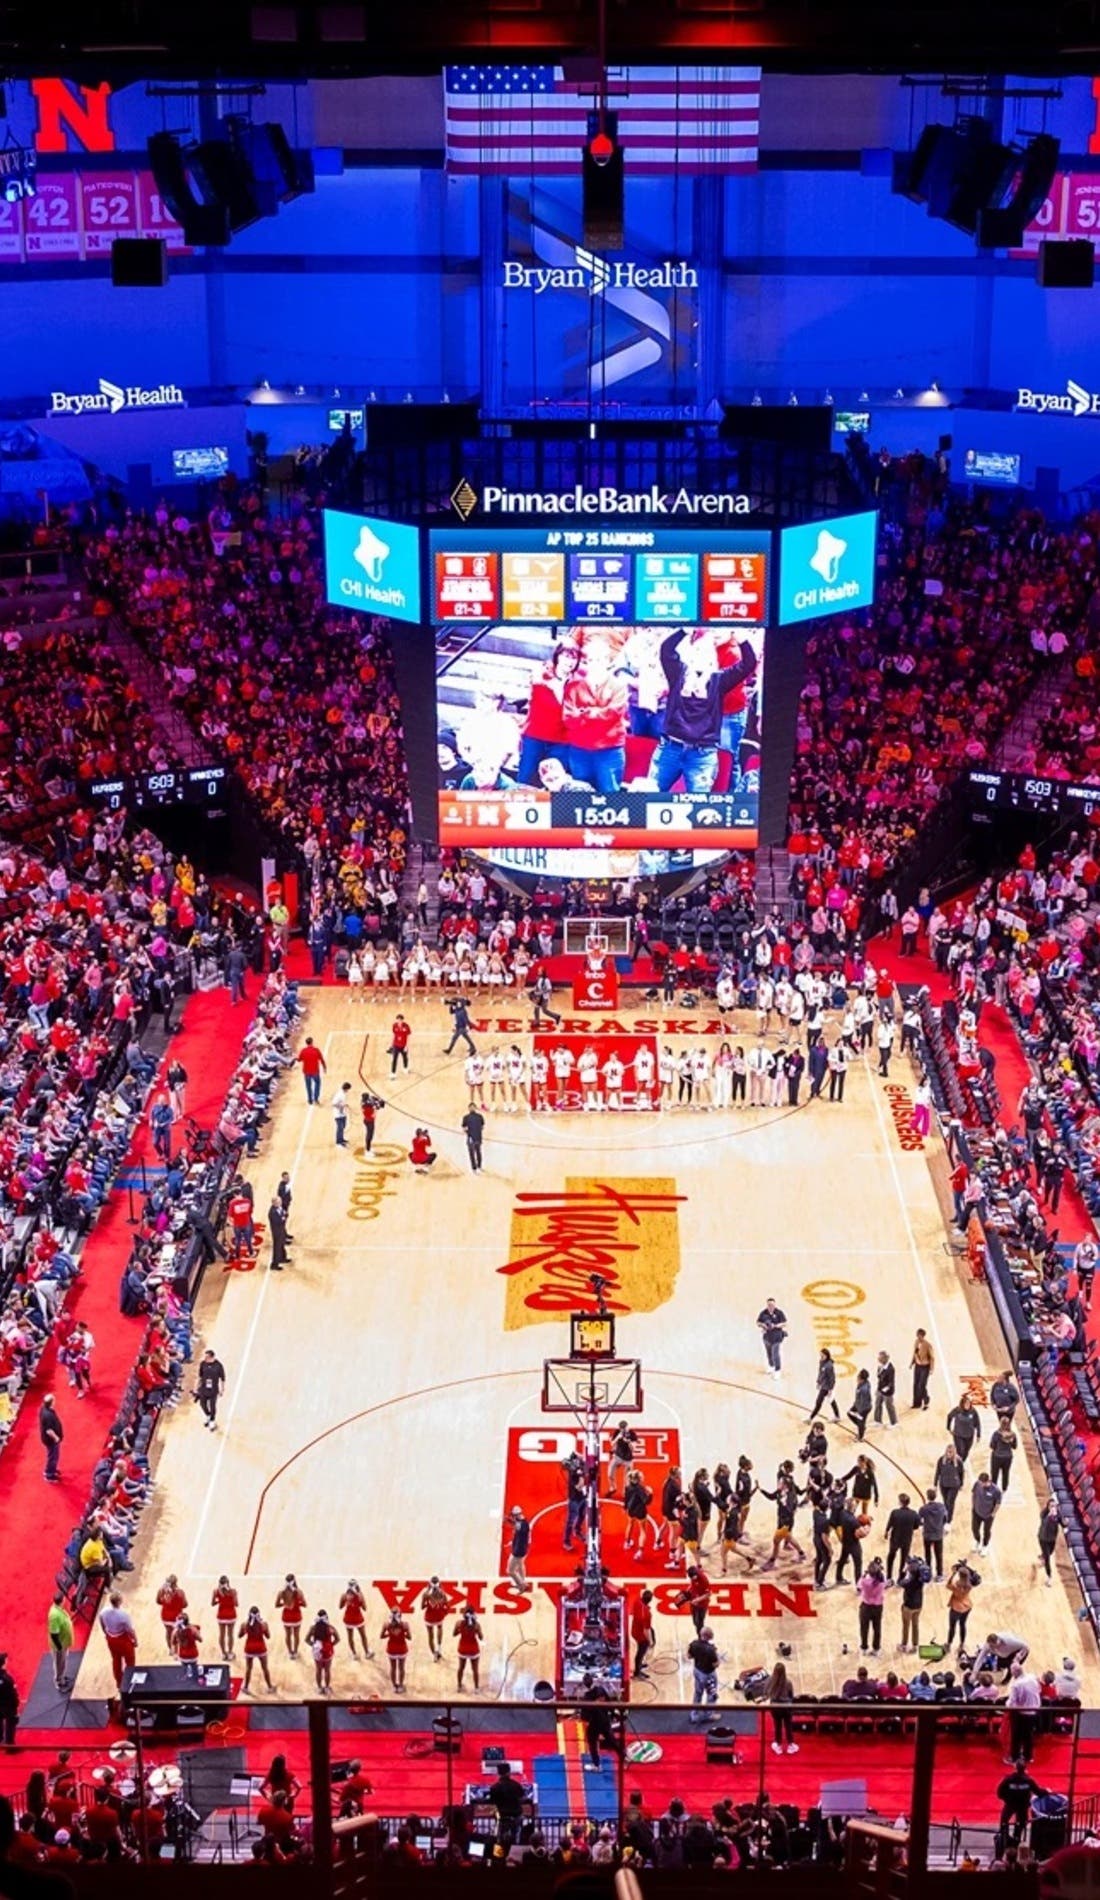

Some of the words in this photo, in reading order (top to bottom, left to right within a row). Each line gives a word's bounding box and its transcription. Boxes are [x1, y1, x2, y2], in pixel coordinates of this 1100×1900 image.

[32, 78, 114, 152] N
[29, 197, 70, 227] 42
[90, 196, 130, 225] 52
[503, 262, 585, 294] Bryan
[614, 262, 699, 287] Health
[51, 392, 109, 415] Bryan
[126, 384, 184, 406] Health
[1017, 388, 1073, 413] Bryan
[671, 488, 750, 513] Arena
[546, 532, 562, 546] AP
[563, 532, 584, 546] TOP
[585, 532, 600, 546] 25
[340, 578, 363, 598] CHI
[365, 583, 406, 608] Health
[794, 590, 817, 609] CHI
[819, 580, 860, 603] Health
[525, 808, 539, 824] 0
[574, 808, 629, 826] 15:04
[660, 808, 673, 825] 0
